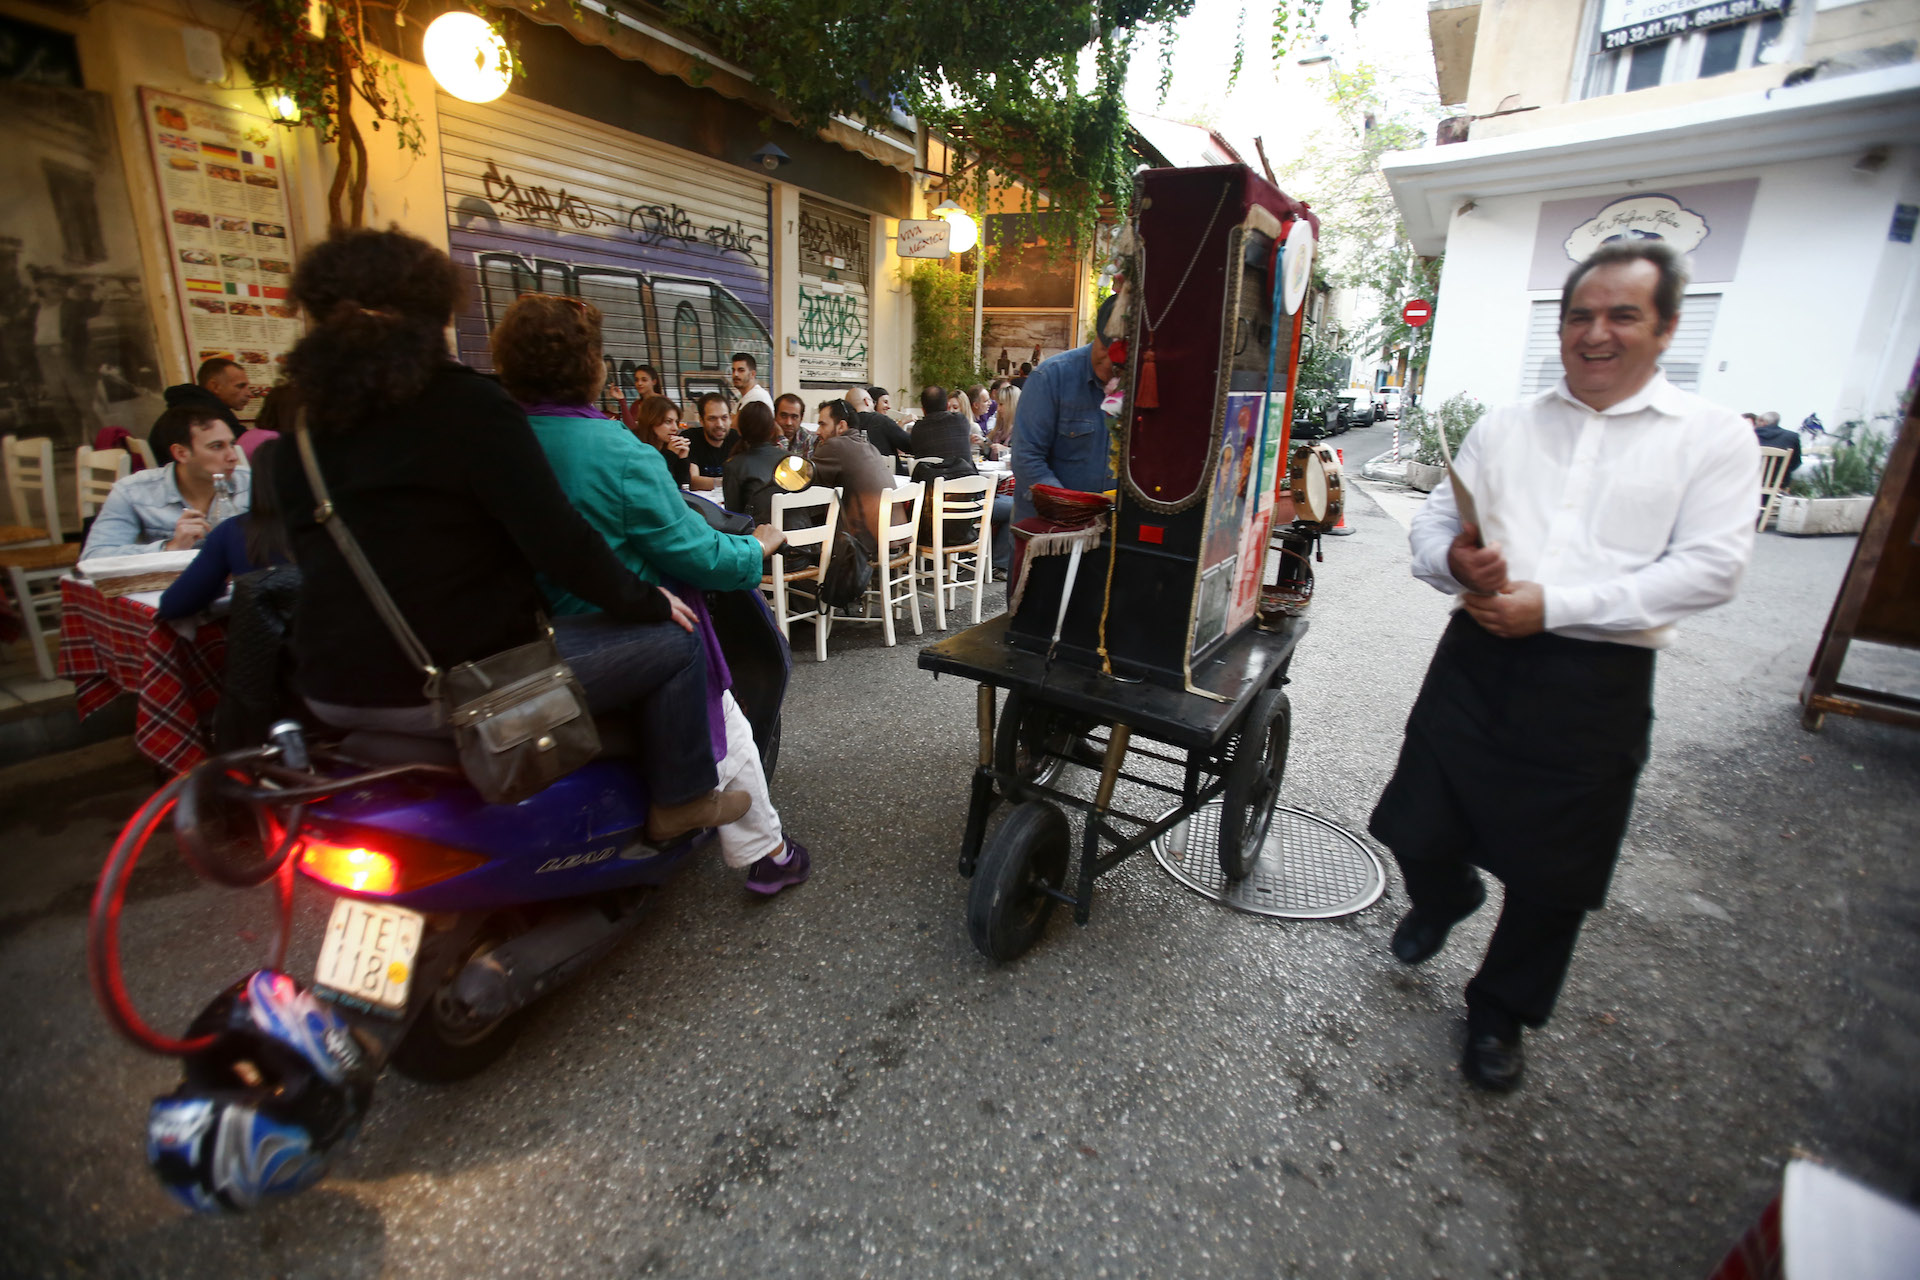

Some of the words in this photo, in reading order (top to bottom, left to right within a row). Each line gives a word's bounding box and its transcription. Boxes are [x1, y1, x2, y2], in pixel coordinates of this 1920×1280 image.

[1606, 32, 1628, 48] 210
[900, 225, 923, 242] VIVA
[908, 229, 947, 256] MEXICO
[330, 943, 384, 992] 118
